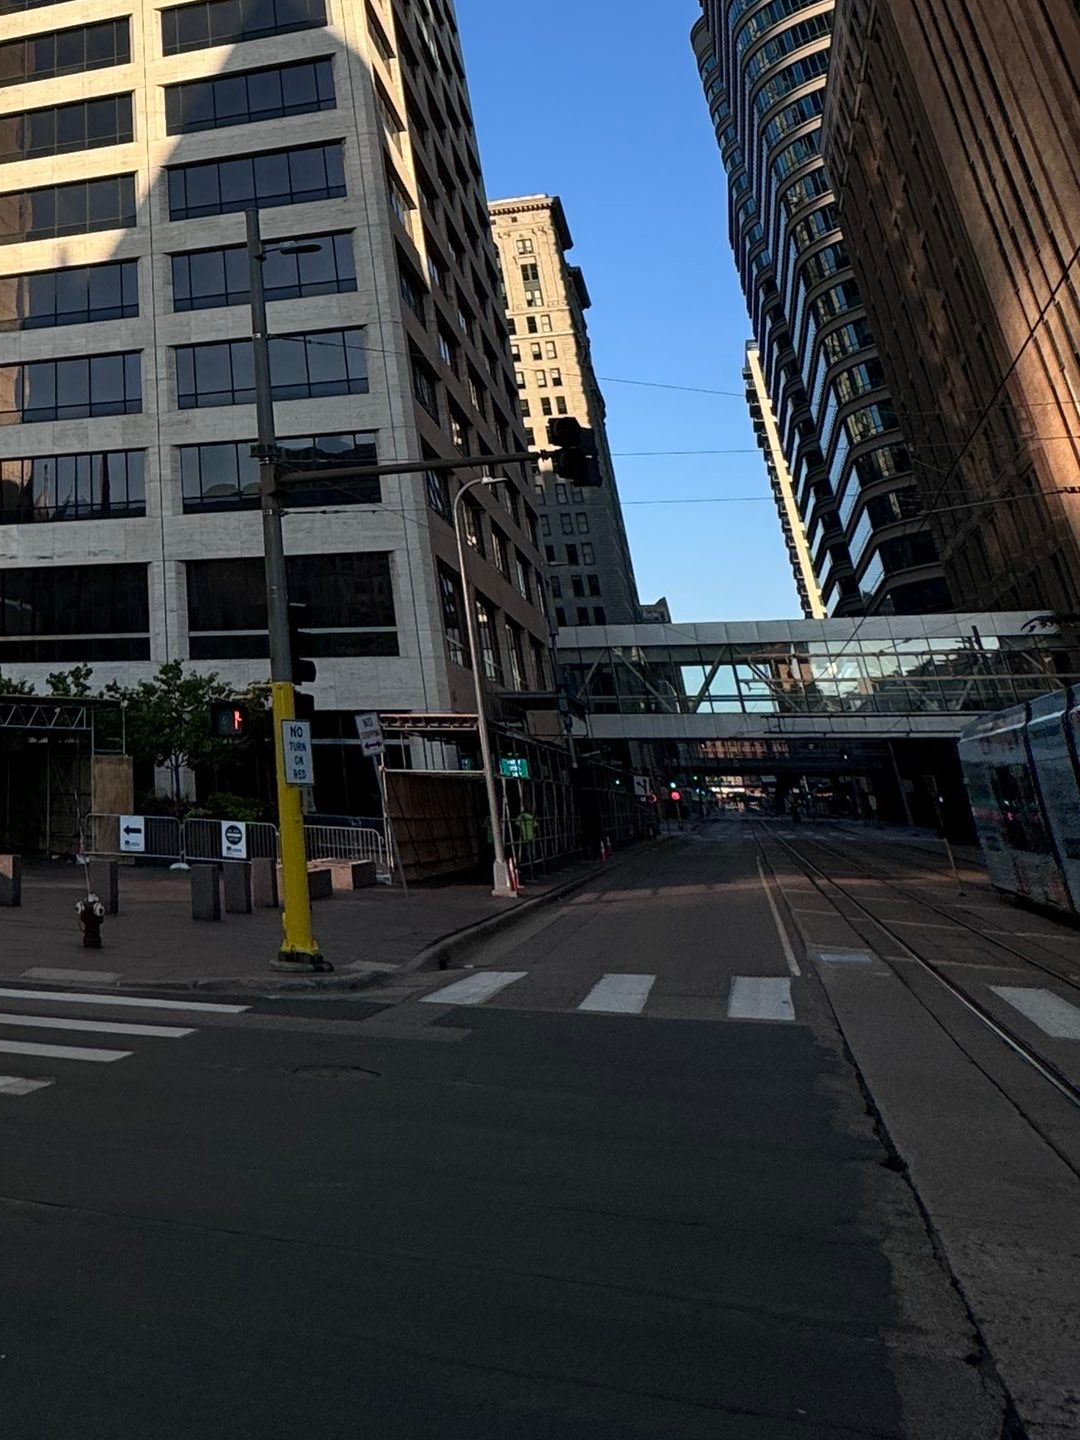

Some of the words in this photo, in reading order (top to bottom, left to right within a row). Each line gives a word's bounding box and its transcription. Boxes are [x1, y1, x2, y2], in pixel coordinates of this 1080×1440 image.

[290, 725, 303, 738] NO
[289, 742, 307, 751] TURN
[294, 755, 304, 766] ON
[293, 769, 307, 780] RED
